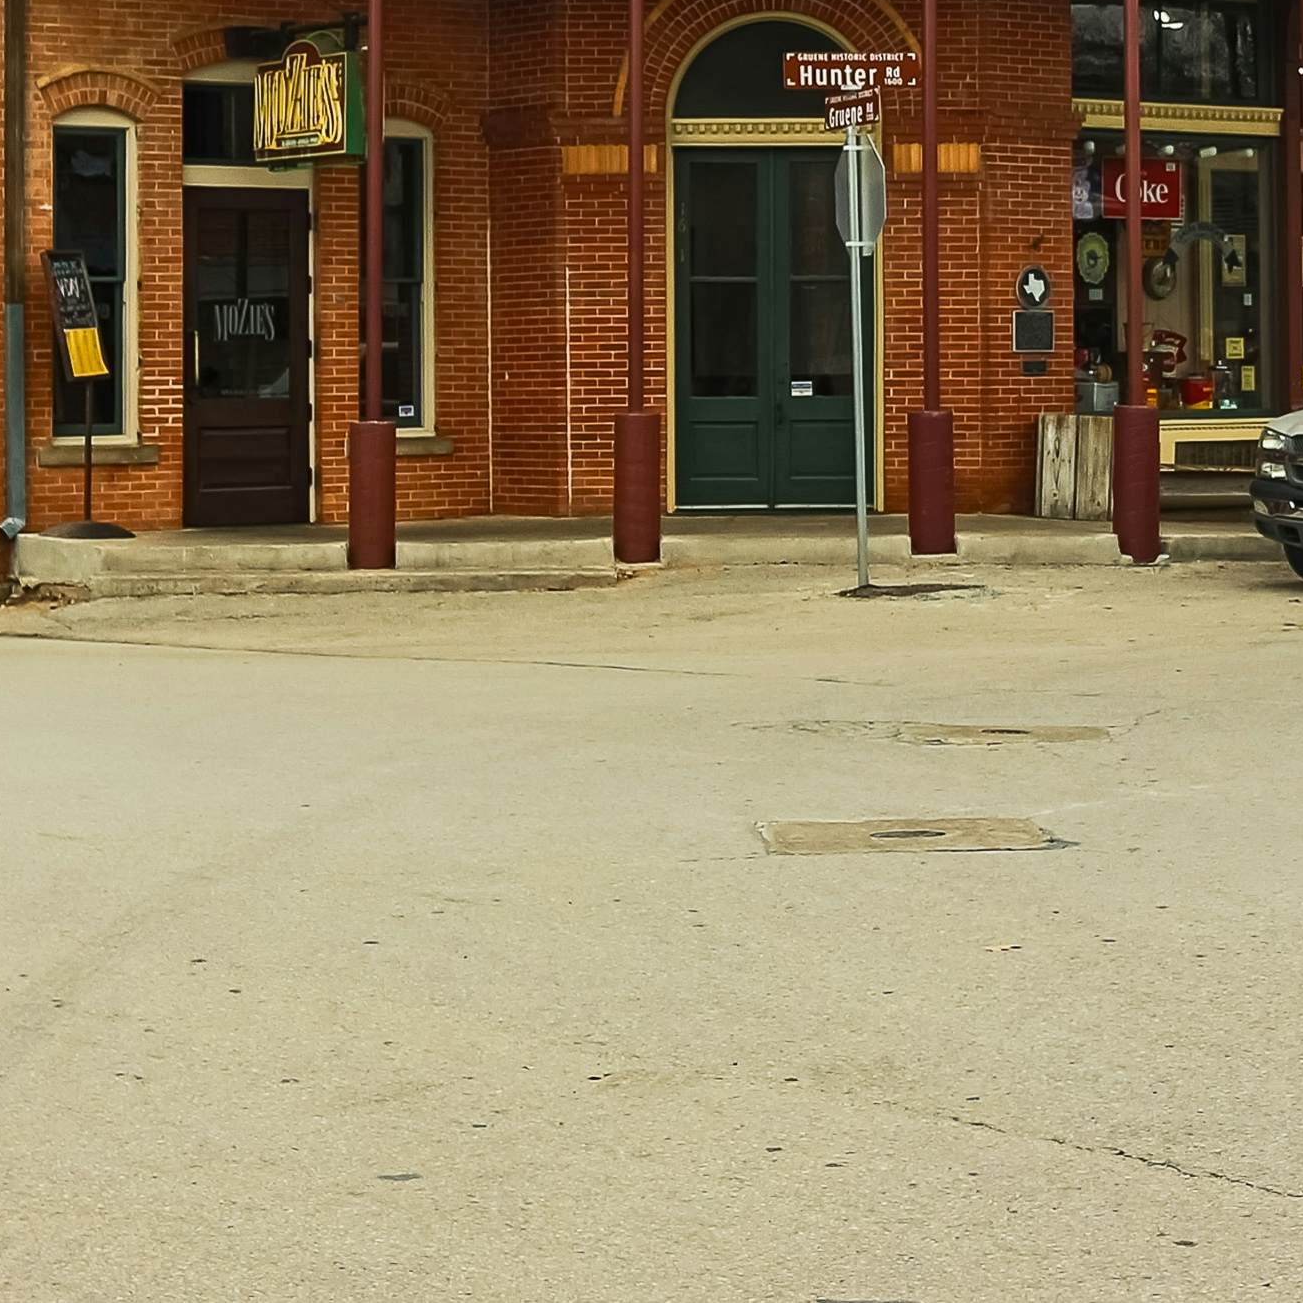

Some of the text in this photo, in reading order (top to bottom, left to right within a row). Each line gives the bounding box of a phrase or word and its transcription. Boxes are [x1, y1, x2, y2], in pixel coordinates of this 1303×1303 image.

[797, 52, 904, 62] GRUENE HISTORIC DISTRICT
[799, 64, 901, 86] Hunter Rd
[883, 77, 903, 86] 1600
[828, 105, 863, 128] Gruene
[1115, 173, 1169, 204] Cke
